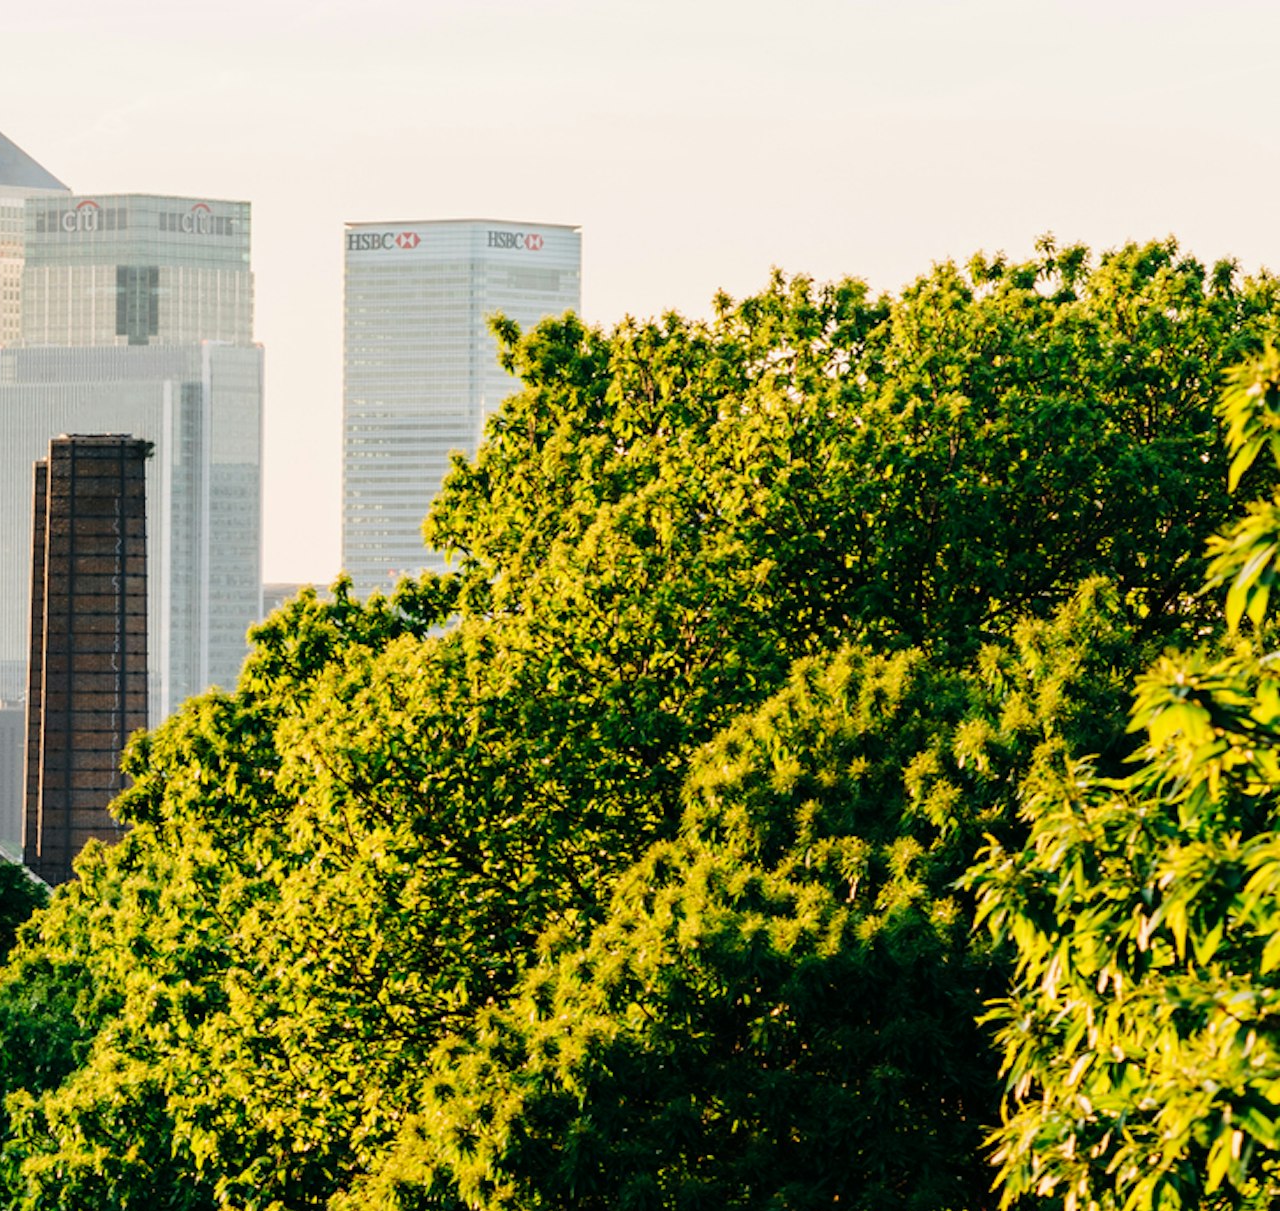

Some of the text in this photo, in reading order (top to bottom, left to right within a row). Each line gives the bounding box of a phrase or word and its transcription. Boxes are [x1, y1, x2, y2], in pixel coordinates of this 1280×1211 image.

[62, 205, 98, 232] citi
[182, 208, 212, 235] citi
[347, 232, 394, 251] HSBC
[487, 230, 523, 250] HSBC
